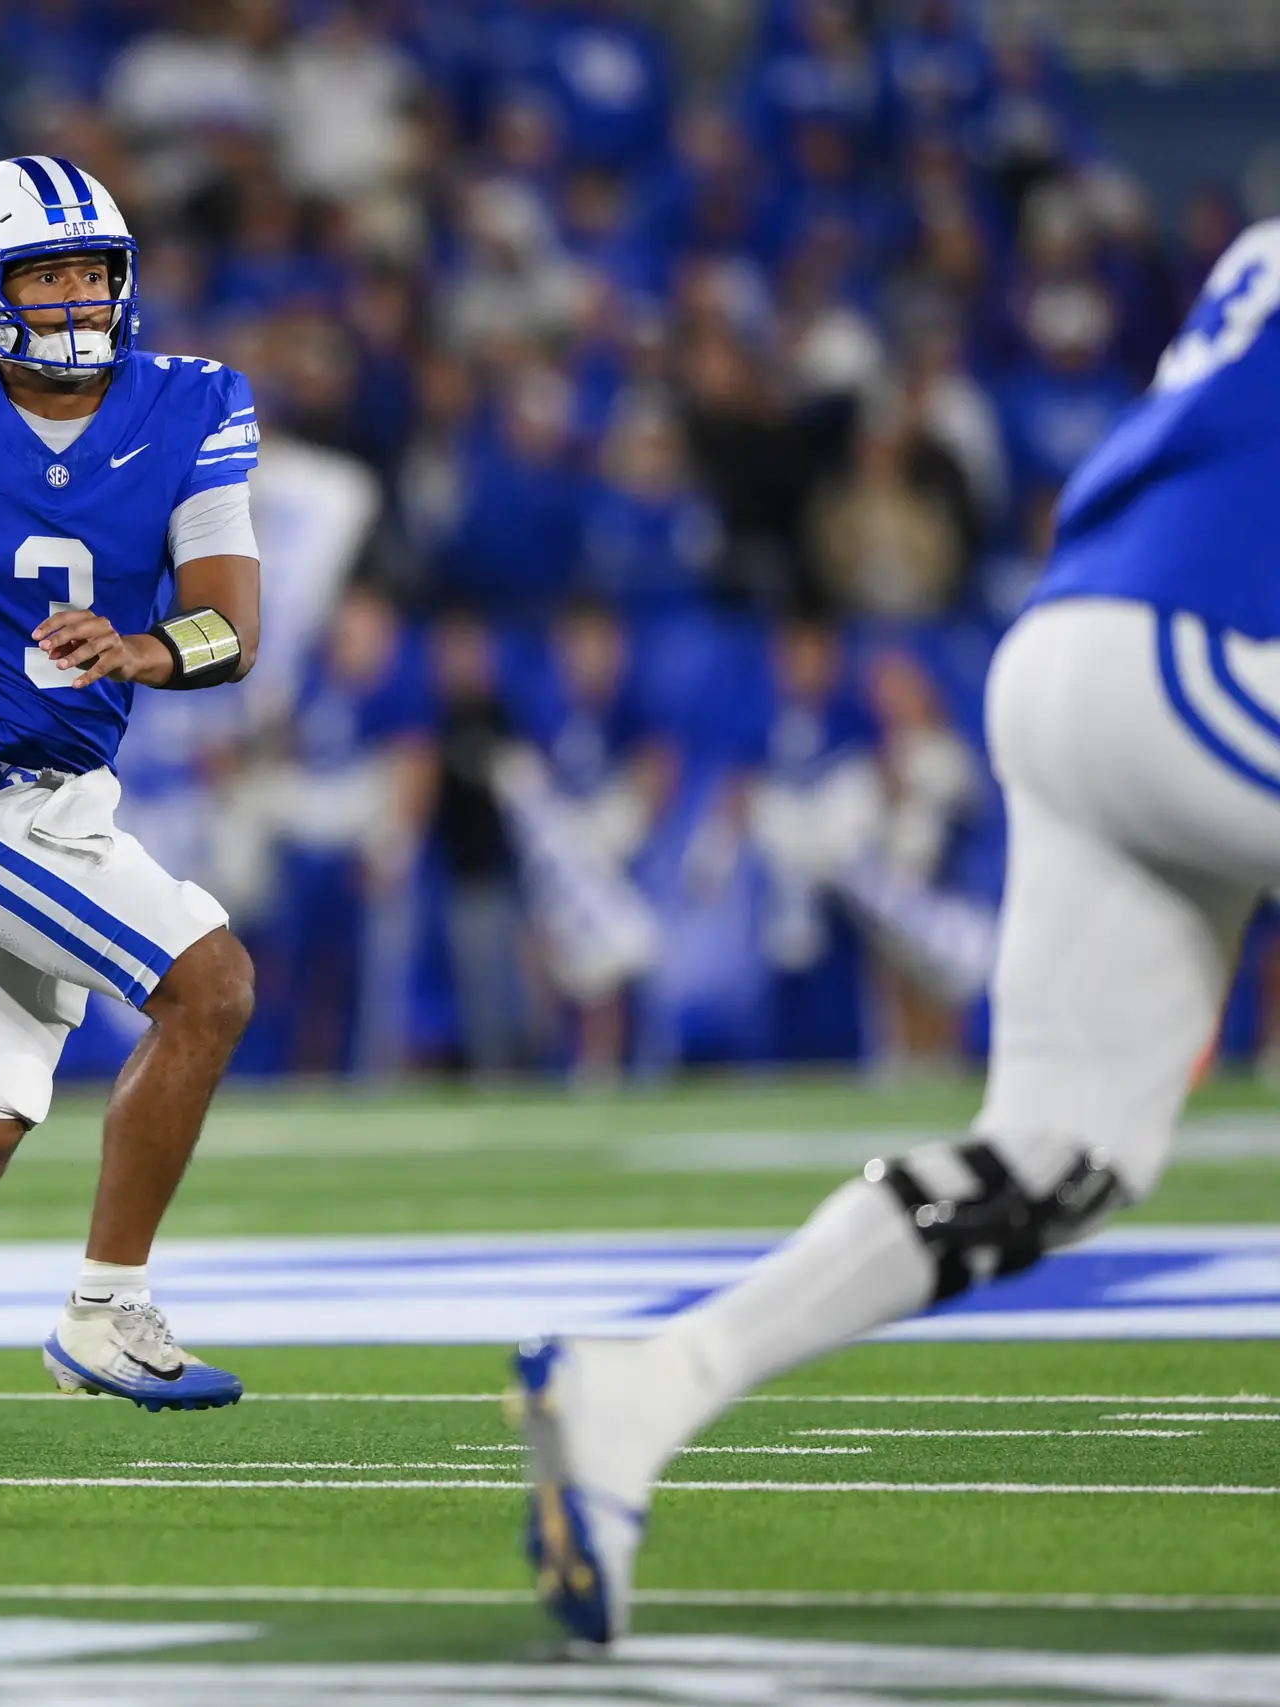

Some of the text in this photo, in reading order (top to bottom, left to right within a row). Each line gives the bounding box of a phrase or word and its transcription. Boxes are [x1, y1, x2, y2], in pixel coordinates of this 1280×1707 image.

[64, 221, 95, 236] CATS
[48, 465, 68, 485] SEC
[14, 536, 94, 689] 3
